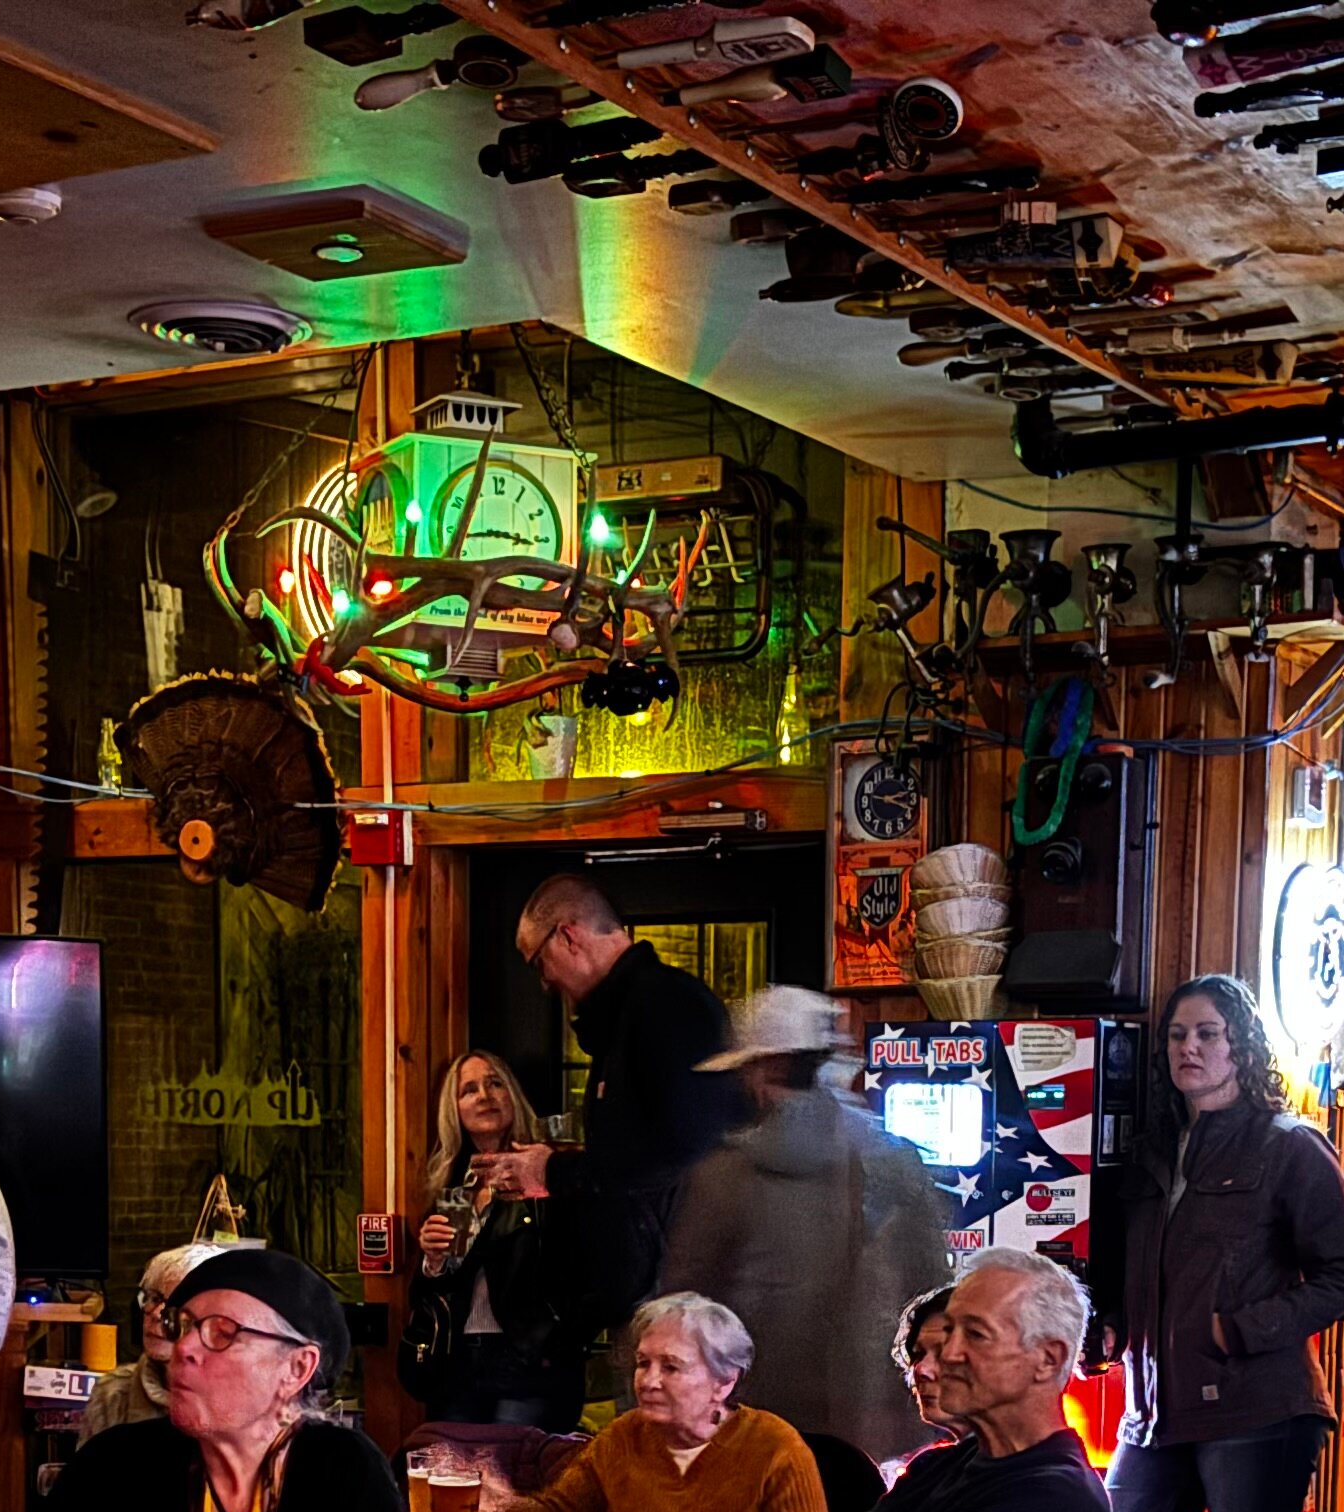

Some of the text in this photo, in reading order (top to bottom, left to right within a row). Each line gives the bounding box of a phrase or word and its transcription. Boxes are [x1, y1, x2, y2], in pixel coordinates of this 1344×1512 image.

[492, 475, 506, 496] 12
[864, 782, 873, 794] 10
[907, 778, 915, 791] 2
[862, 796, 869, 809] 9
[910, 792, 917, 806] 3
[864, 809, 872, 823] 8
[872, 819, 880, 832] 7
[885, 822, 893, 835] 6
[897, 818, 905, 831] 5
[874, 876, 897, 896] Old
[862, 894, 897, 923] Style
[872, 1039, 984, 1065] PULL TABS
[361, 1216, 388, 1231] FIRE
